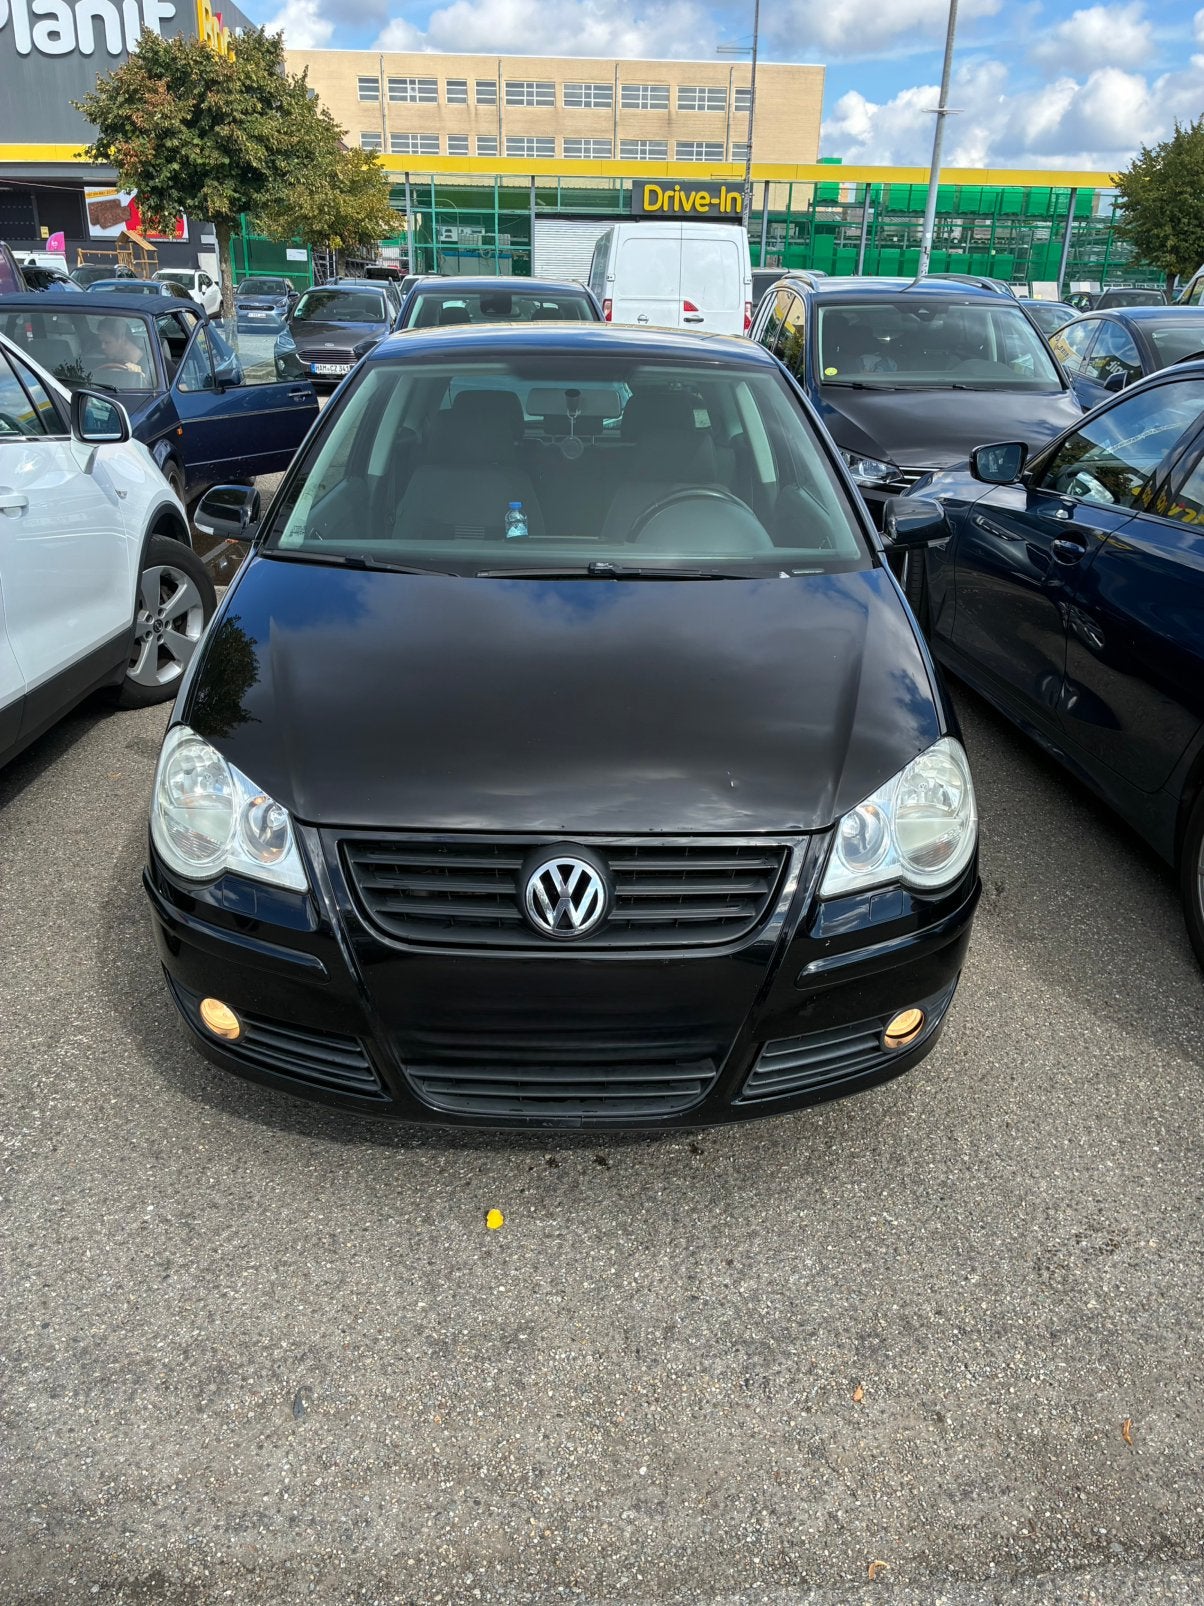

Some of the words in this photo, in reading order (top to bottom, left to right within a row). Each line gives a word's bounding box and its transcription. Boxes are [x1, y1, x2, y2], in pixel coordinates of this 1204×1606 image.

[0, 0, 176, 55] lanit
[643, 184, 742, 213] Drive-In
[526, 858, 604, 937] VW
